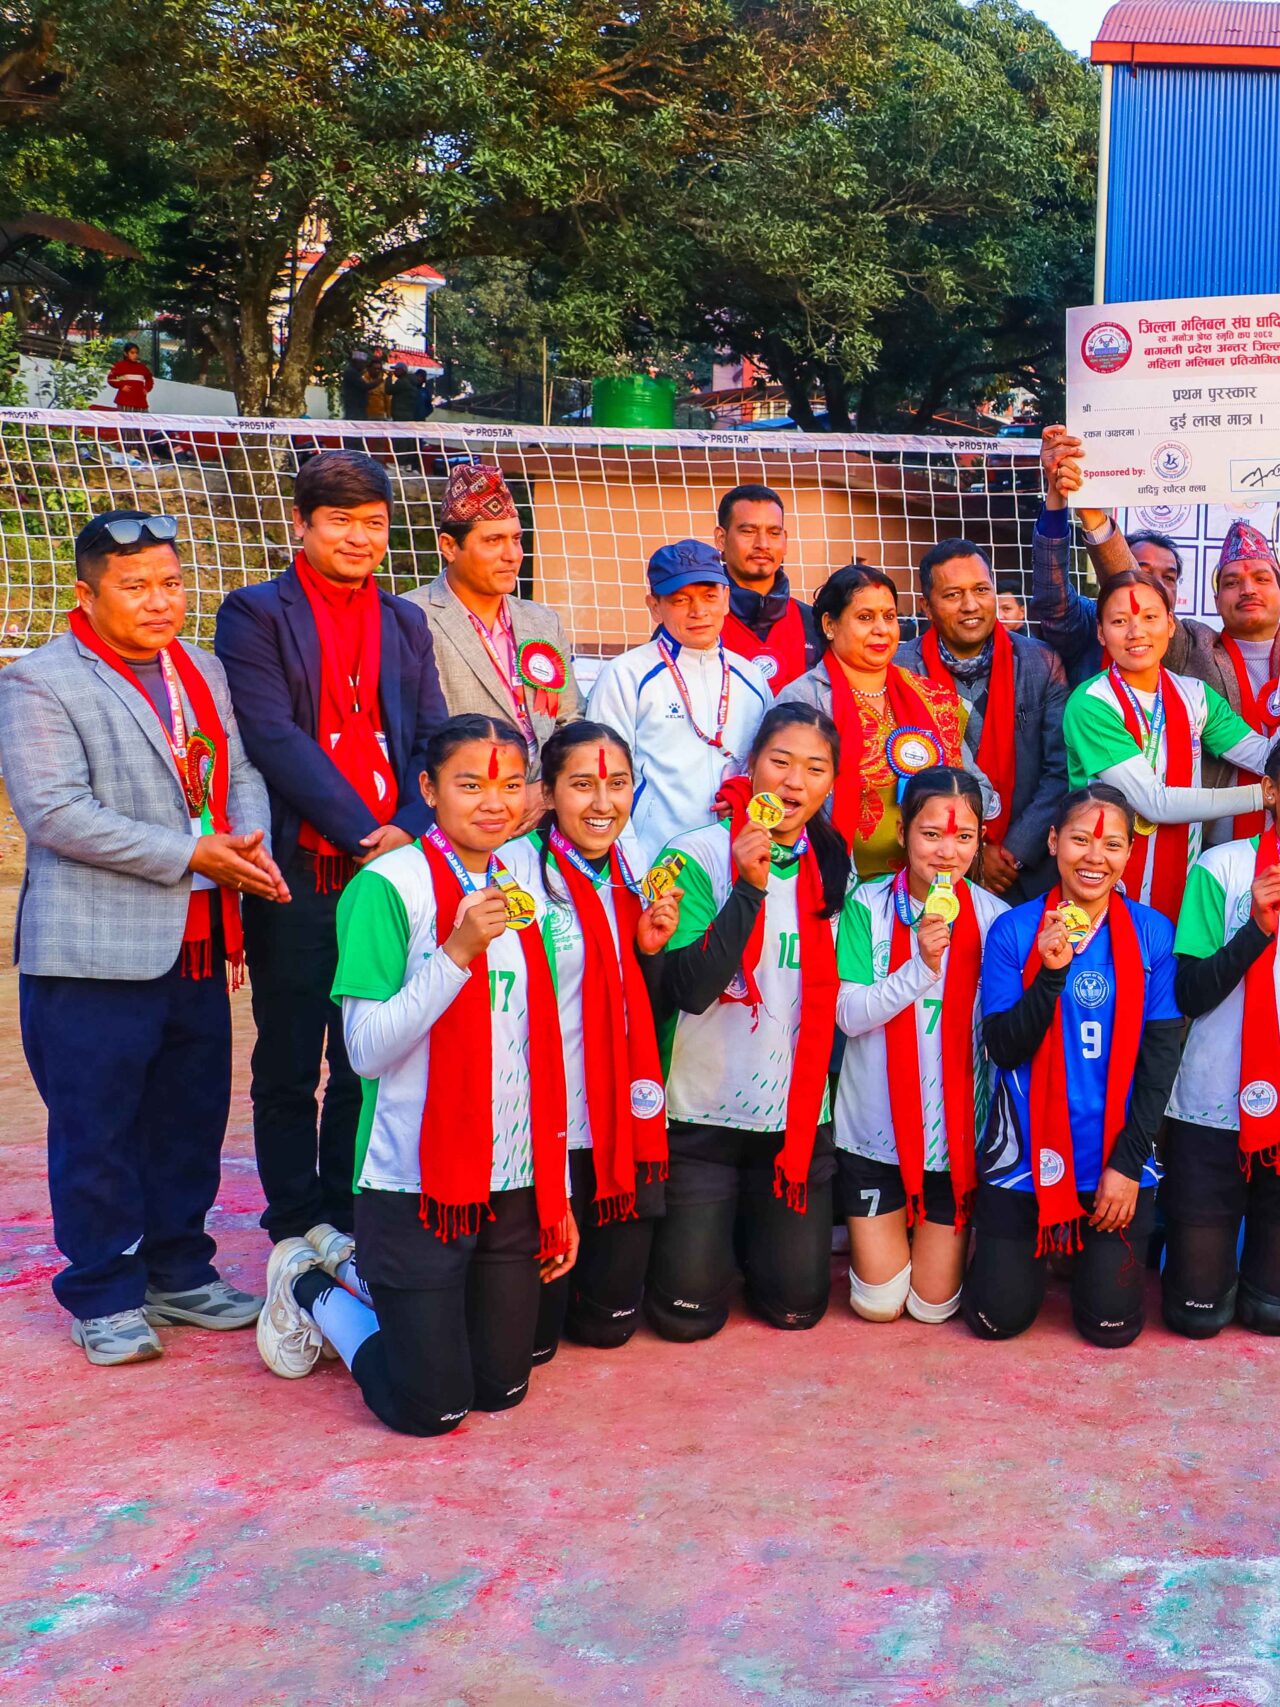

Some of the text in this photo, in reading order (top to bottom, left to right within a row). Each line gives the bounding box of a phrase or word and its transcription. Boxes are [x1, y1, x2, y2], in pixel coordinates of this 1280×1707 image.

[1139, 318, 1176, 335] जिल्ला
[1181, 316, 1227, 332] भलिबल
[1231, 315, 1250, 329] संघ
[1237, 331, 1251, 339] कप
[1253, 331, 1273, 339] २०८२
[1144, 344, 1183, 357] बागमती
[1187, 342, 1212, 356] प्रदेश
[1217, 343, 1247, 354] अन्तर
[1147, 357, 1181, 370] महिला
[1185, 356, 1225, 367] भलिबल
[1172, 386, 1258, 402] प्रथम पुरस्कार
[240, 420, 275, 430] PROSTAR
[1169, 413, 1187, 431] दुई
[1193, 414, 1221, 427] लाख
[1227, 413, 1253, 426] मात्र
[476, 428, 513, 438] PROSTAR
[710, 434, 749, 445] PROSTAR
[958, 441, 998, 451] PROSTAR
[1084, 468, 1131, 479] Sponsored
[1132, 467, 1146, 477] by:
[488, 970, 516, 1012] 17
[922, 999, 942, 1035] 7
[1080, 1021, 1102, 1059] 9
[860, 1189, 881, 1218] 7
